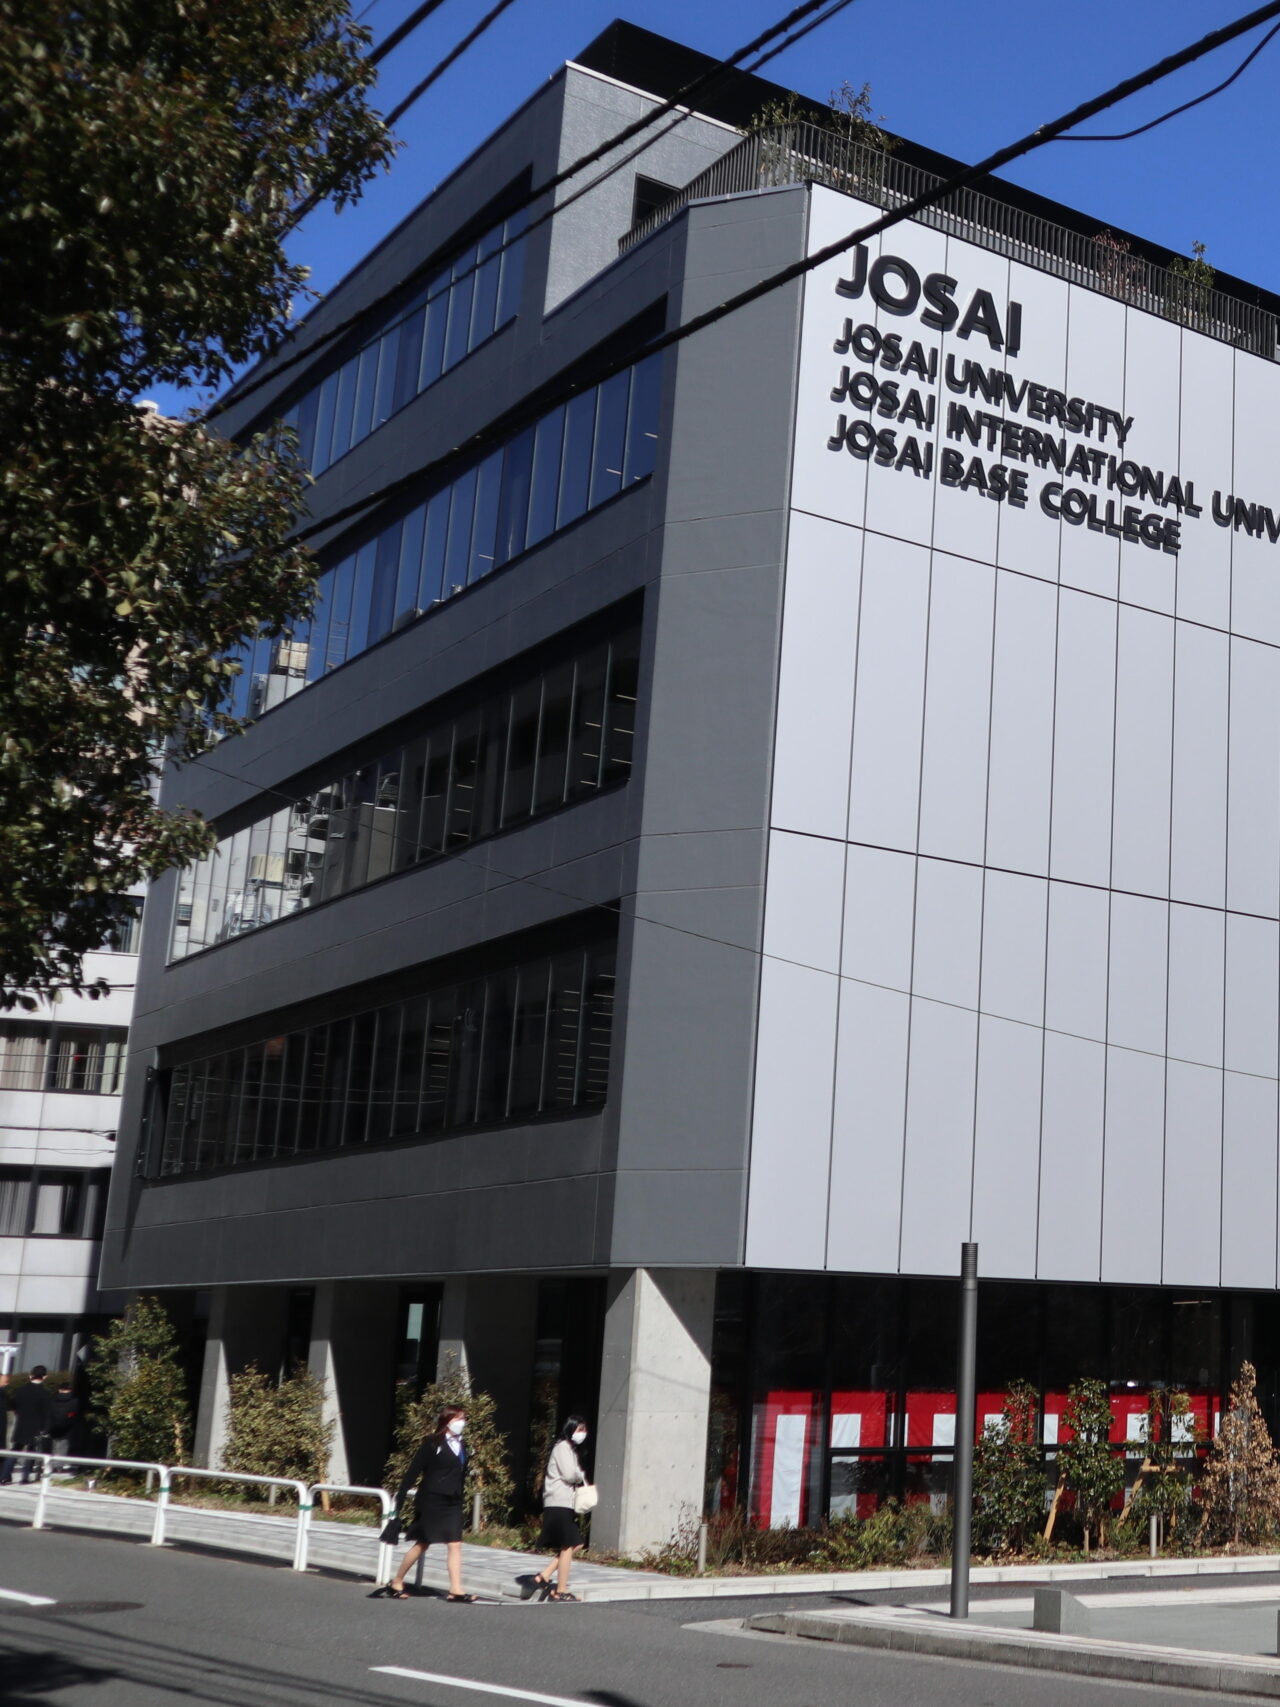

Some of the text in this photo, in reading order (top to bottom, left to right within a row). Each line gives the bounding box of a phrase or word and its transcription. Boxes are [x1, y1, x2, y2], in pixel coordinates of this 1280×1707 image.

[835, 243, 1022, 358] JOSAI
[830, 365, 935, 431] JOSAI
[946, 401, 1202, 518] INTERNATIONAL
[833, 317, 1134, 448] JOSAI UNIVERSITY
[827, 414, 1181, 556] JOSAI BASE COLLEGE
